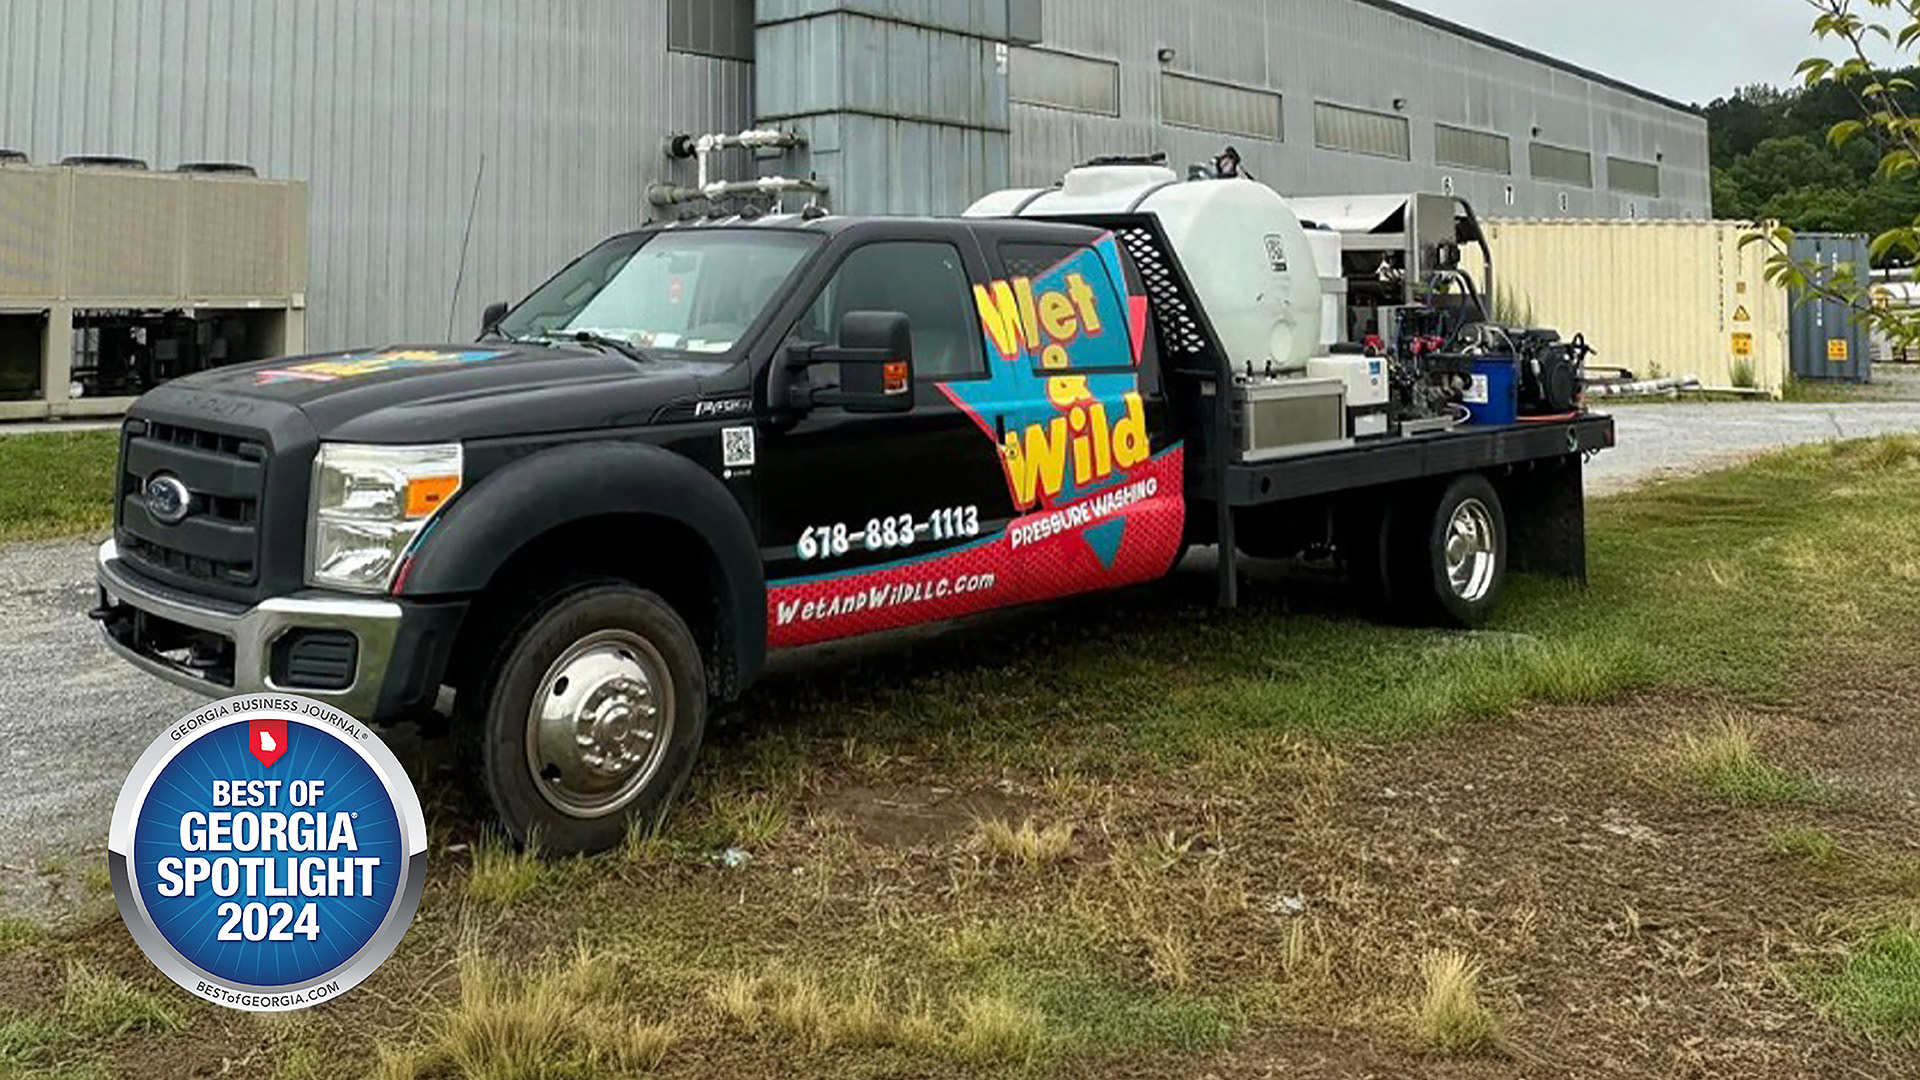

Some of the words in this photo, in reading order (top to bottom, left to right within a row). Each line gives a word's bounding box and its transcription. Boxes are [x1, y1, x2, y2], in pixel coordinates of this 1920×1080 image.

[972, 273, 1102, 357] Wet
[1041, 344, 1092, 406] &
[1004, 392, 1150, 504] Wild
[797, 505, 980, 560] 678-883-1113
[1011, 501, 1091, 550] PRESSURE
[1090, 477, 1158, 517] WASHING
